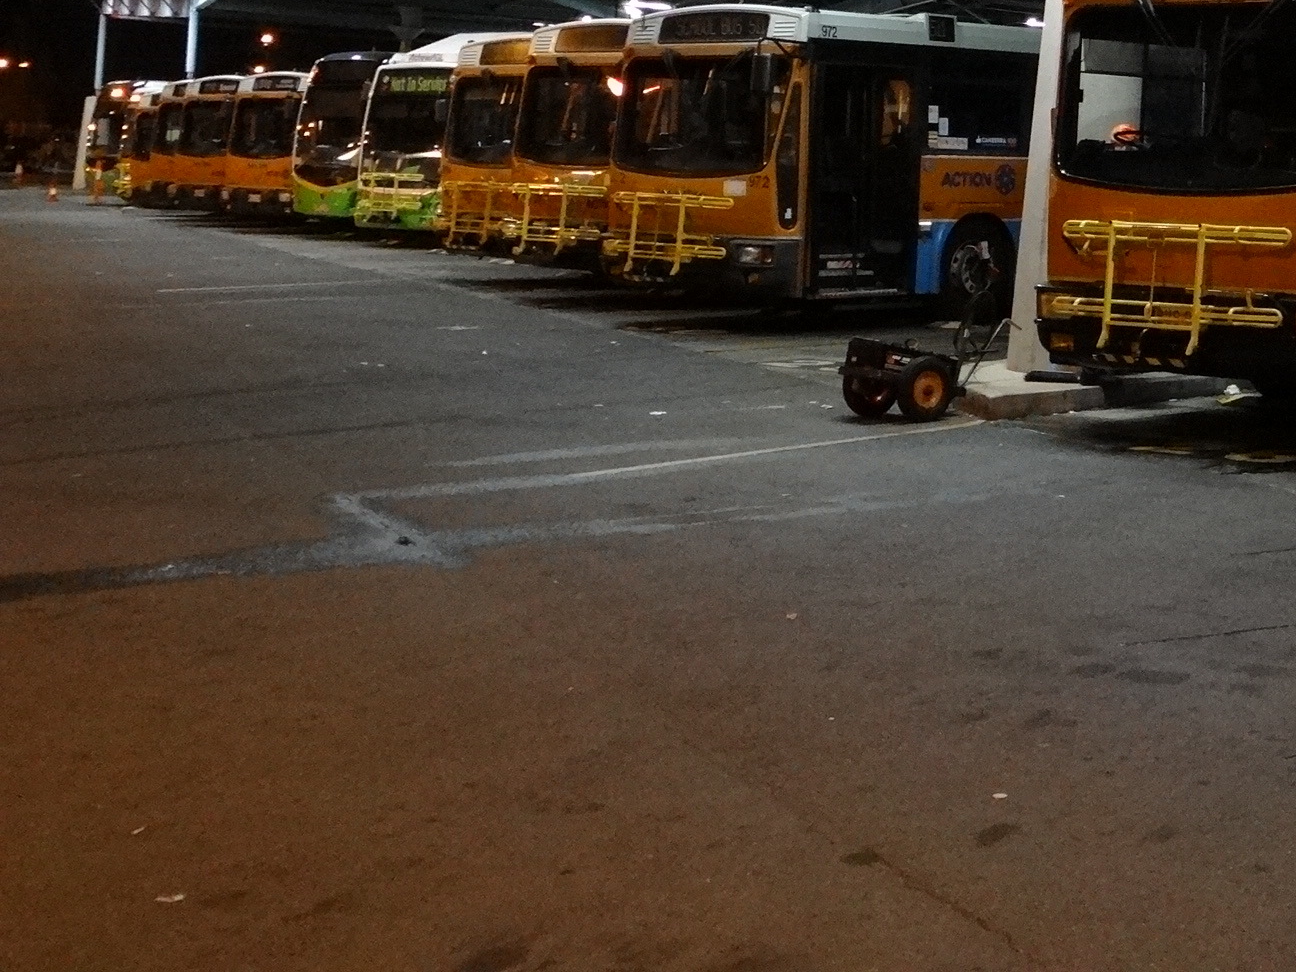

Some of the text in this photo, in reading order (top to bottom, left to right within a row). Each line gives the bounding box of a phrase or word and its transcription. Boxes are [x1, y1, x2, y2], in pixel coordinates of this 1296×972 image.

[821, 25, 838, 38] 972
[750, 175, 770, 189] 972
[941, 171, 992, 187] ACTION
